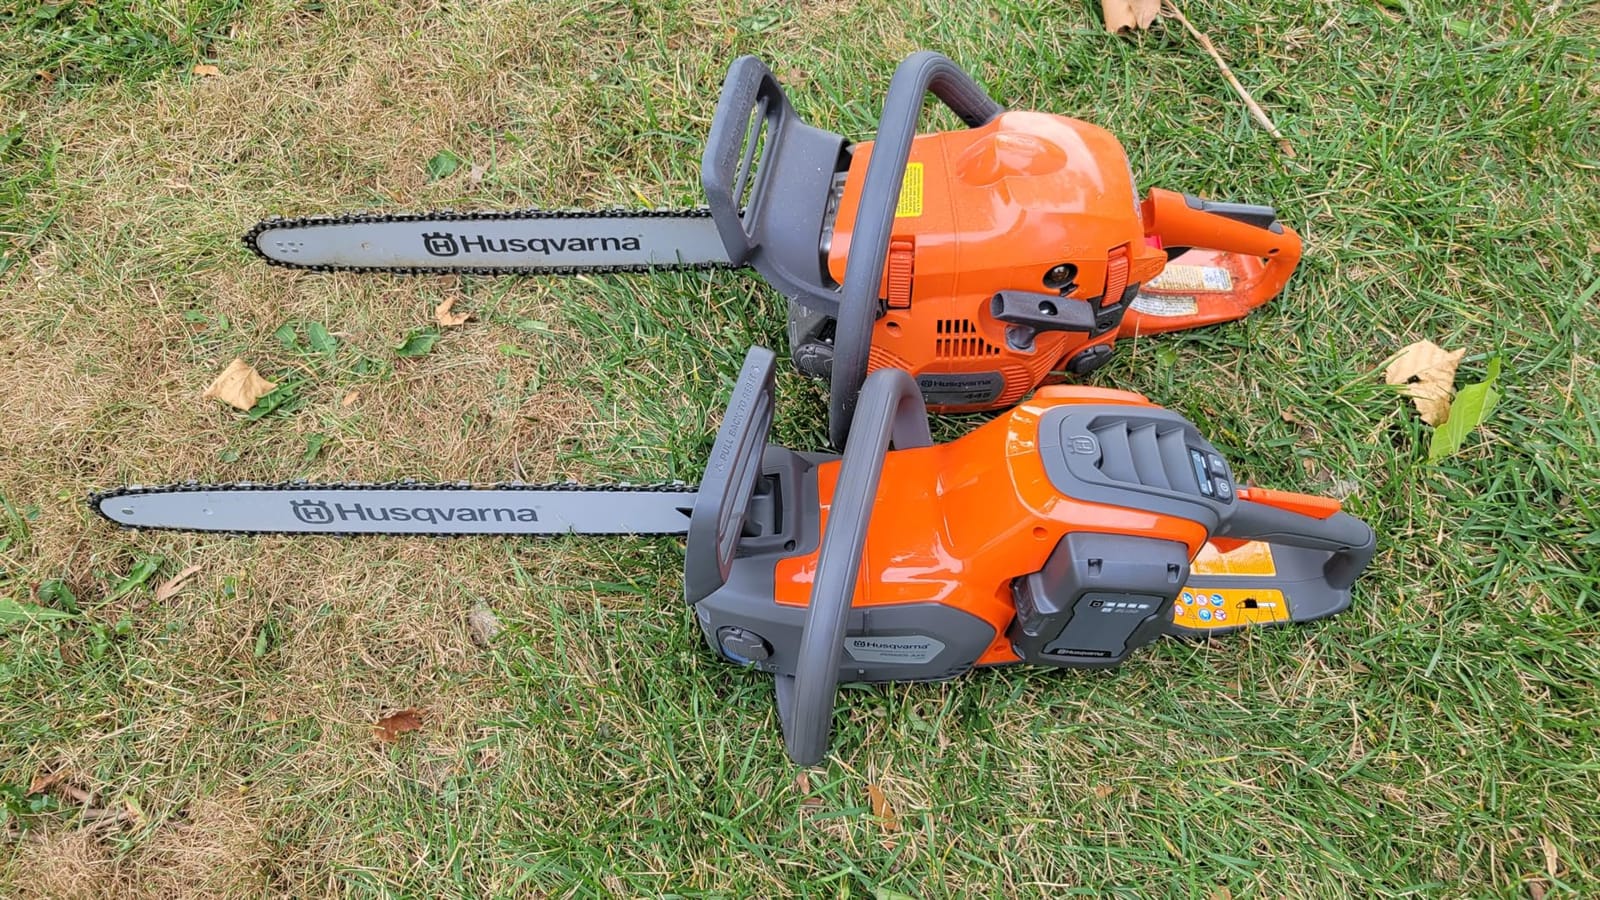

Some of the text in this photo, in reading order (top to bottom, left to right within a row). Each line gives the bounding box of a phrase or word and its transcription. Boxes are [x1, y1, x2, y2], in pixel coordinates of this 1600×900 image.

[460, 235, 641, 255] Husqvarna
[719, 438, 733, 461] PULL
[729, 413, 743, 437] BACK
[737, 400, 748, 413] TO
[334, 503, 539, 524] Husqvarna
[866, 641, 928, 649] Husqvarna
